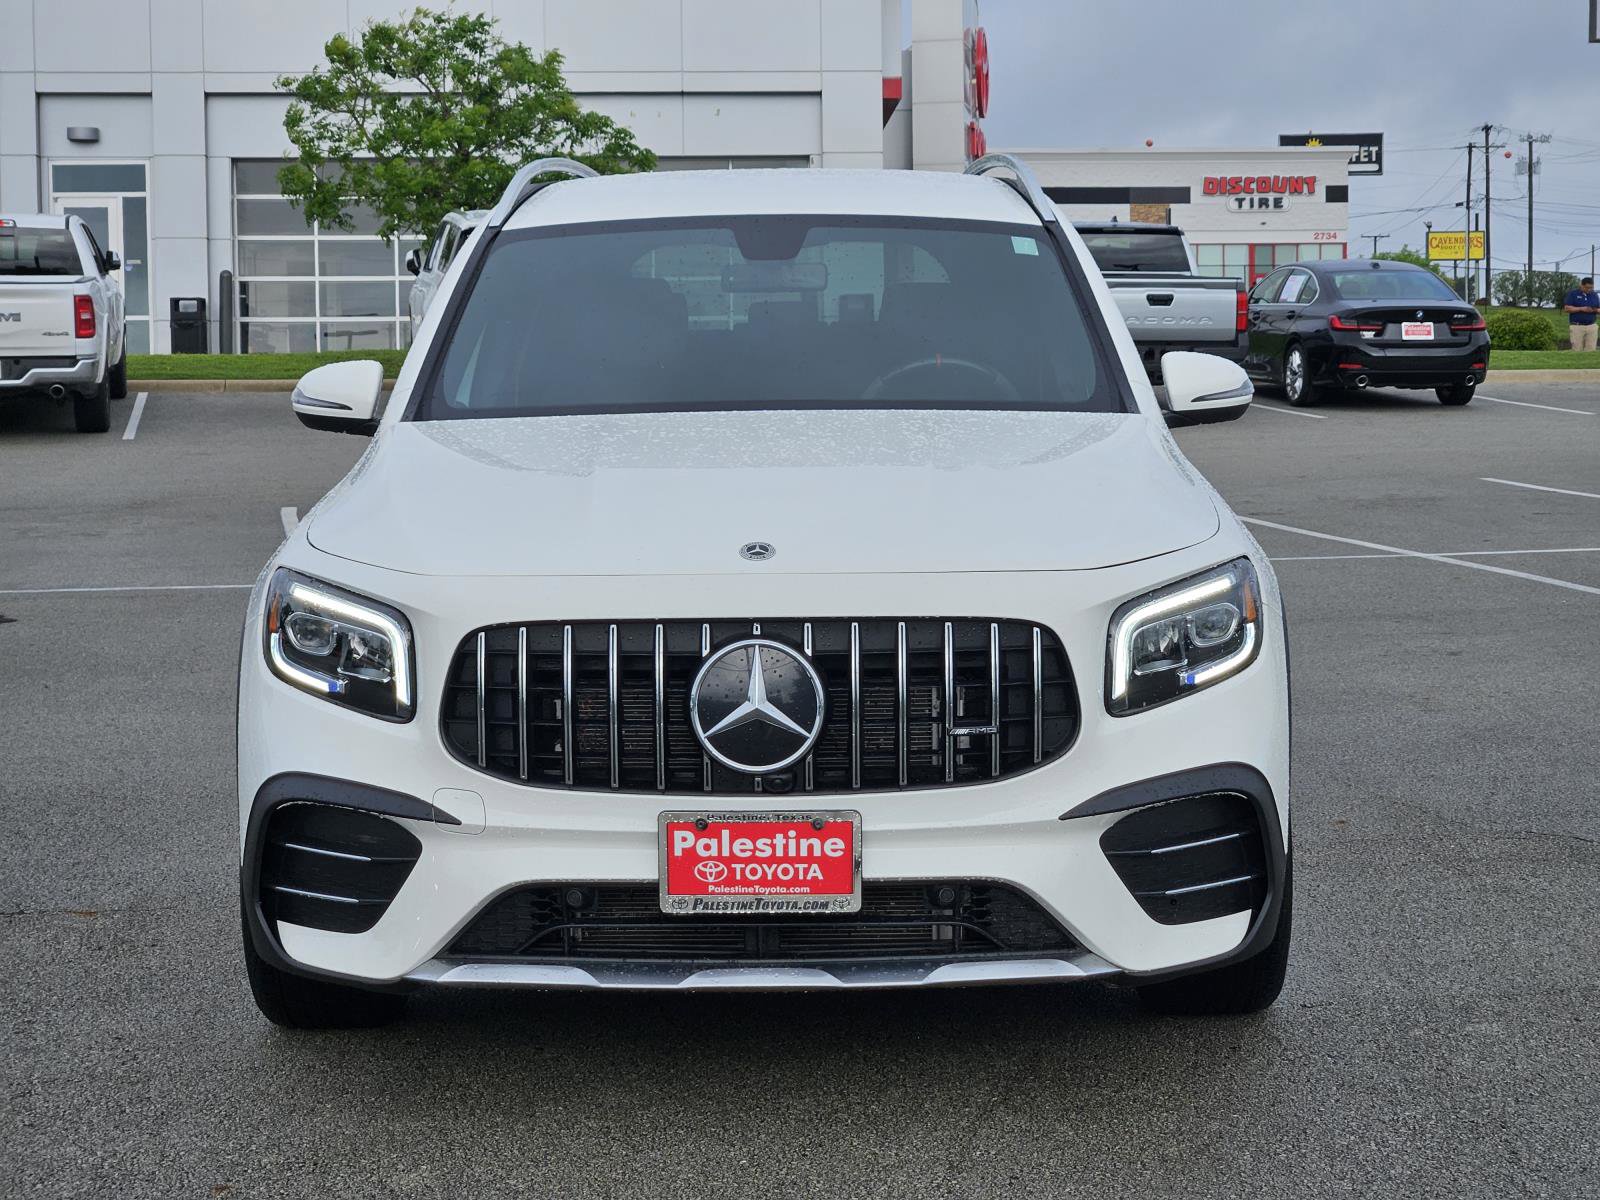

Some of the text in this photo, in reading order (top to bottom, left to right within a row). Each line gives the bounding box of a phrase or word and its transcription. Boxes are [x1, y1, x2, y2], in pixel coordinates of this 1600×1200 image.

[1203, 176, 1317, 195] DISCOUNT
[1235, 197, 1284, 209] TIRE
[1313, 232, 1337, 240] 2734
[1430, 236, 1483, 249] CAVENDR'S
[1125, 315, 1213, 325] ACOMA
[775, 814, 812, 822] Texas
[674, 830, 845, 857] Palestine
[732, 863, 824, 880] TOYOTA
[708, 885, 810, 895] PalestineToyota.com
